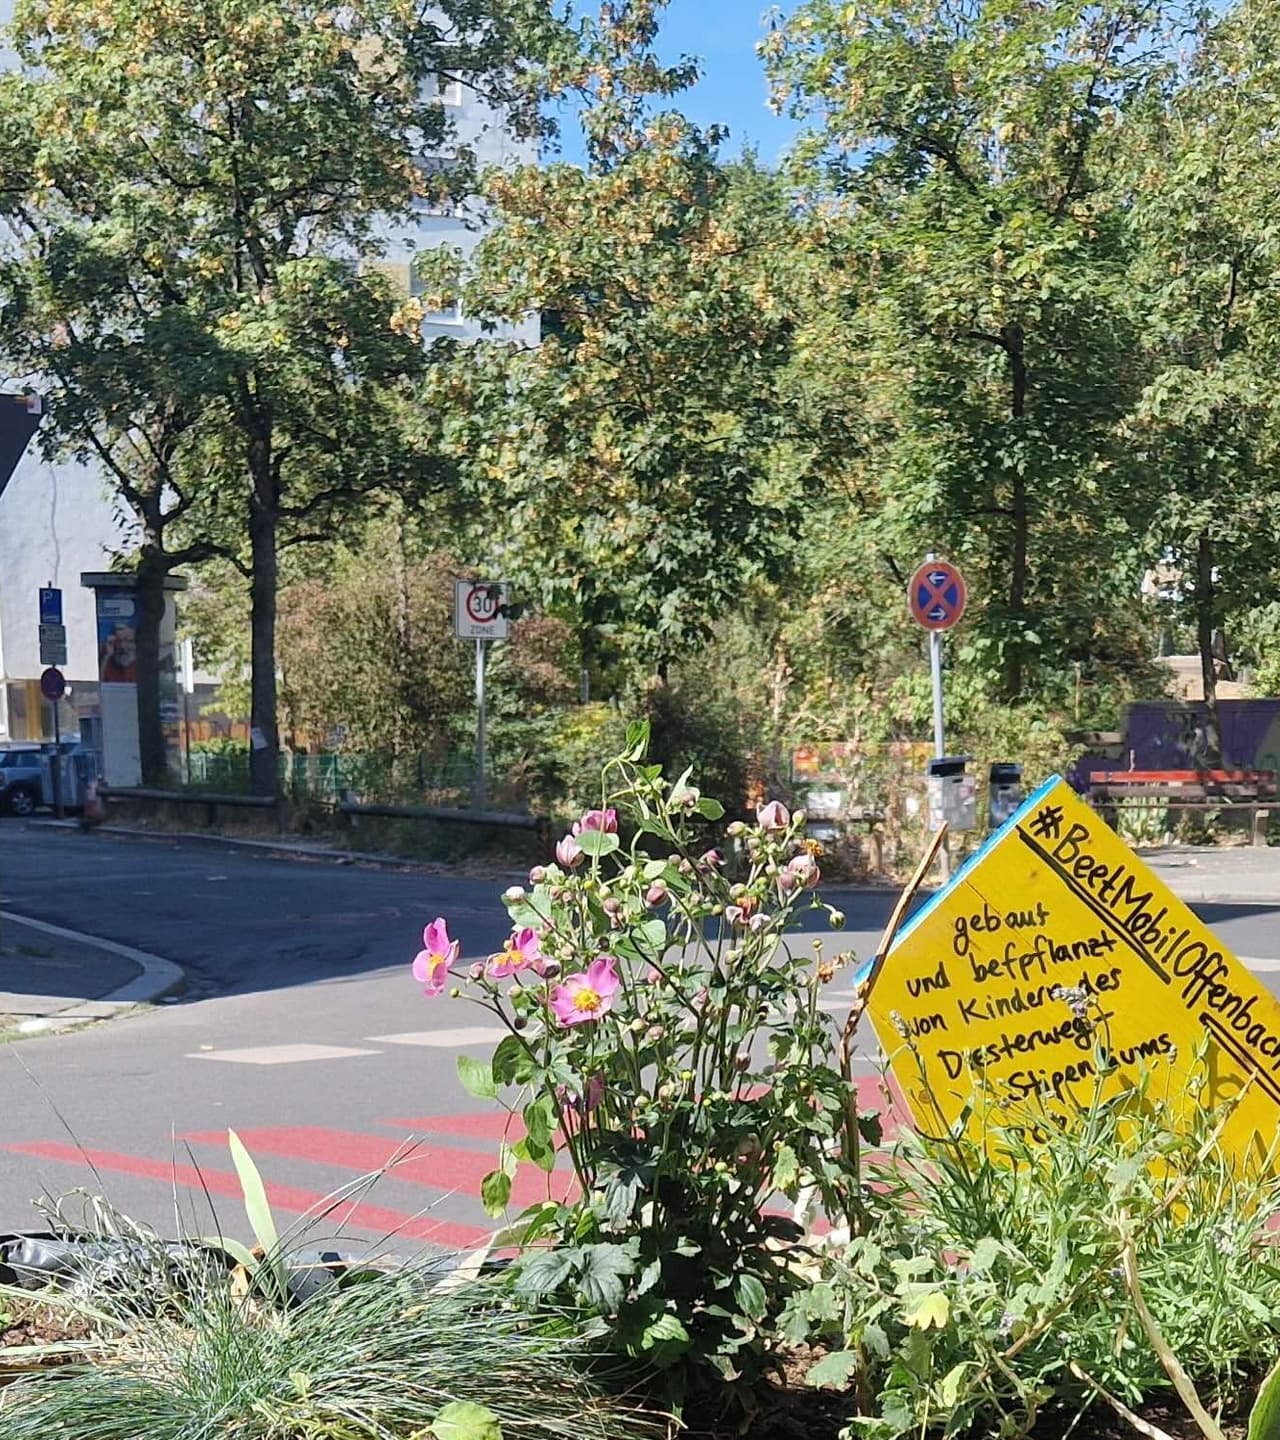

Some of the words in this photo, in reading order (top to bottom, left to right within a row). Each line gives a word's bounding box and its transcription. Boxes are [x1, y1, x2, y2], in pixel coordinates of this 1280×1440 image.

[473, 596, 492, 613] 30
[953, 902, 1050, 957] gebaut
[907, 961, 951, 998] und
[969, 930, 1117, 982] befpflanzt
[908, 1013, 949, 1038] von
[1078, 967, 1122, 996] des
[1008, 1033, 1173, 1103] Stipeniums
